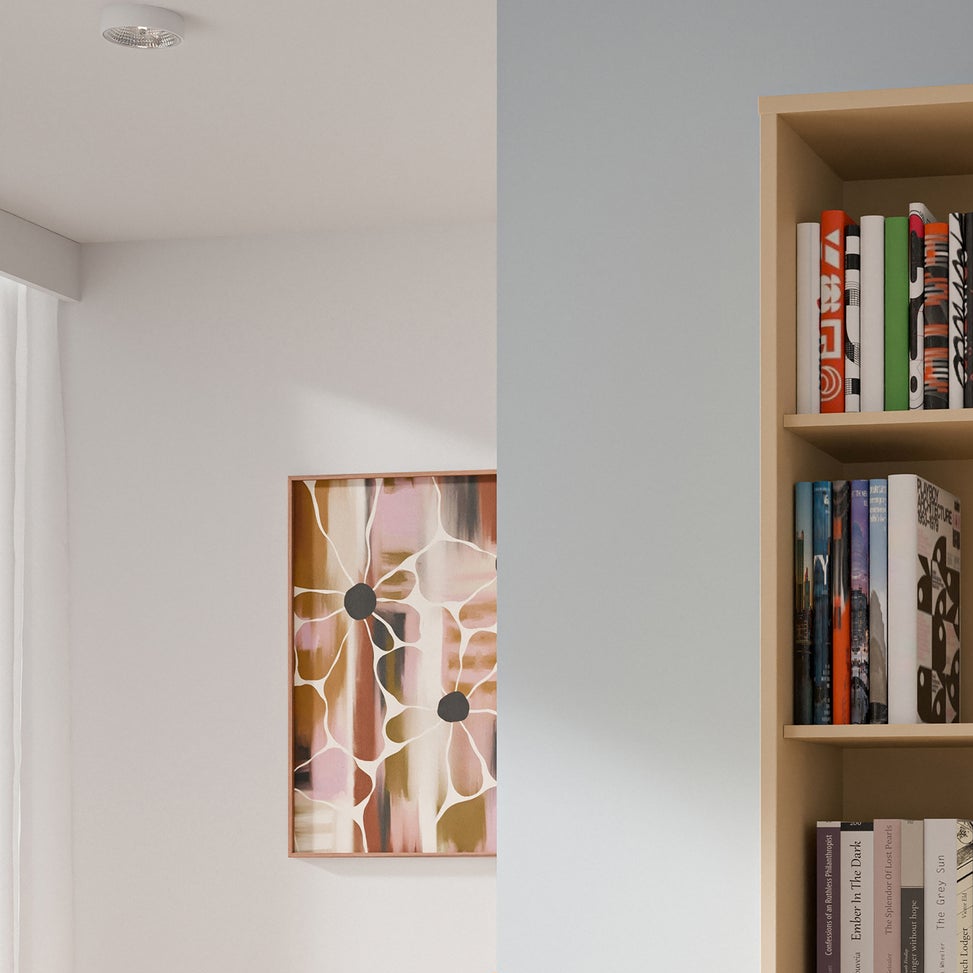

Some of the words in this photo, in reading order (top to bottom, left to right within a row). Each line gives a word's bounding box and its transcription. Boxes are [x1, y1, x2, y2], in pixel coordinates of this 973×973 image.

[825, 835, 833, 877] Philanthropist
[850, 841, 861, 867] Dark
[936, 855, 945, 873] Sun
[850, 871, 861, 890] The
[885, 871, 892, 879] Of
[851, 893, 861, 902] In
[885, 882, 894, 917] Splendor
[936, 881, 946, 905] Grey
[909, 900, 919, 919] hope
[936, 912, 945, 929] The
[850, 906, 861, 940] Ember
[909, 922, 917, 951] without
[960, 928, 970, 956] Lodger
